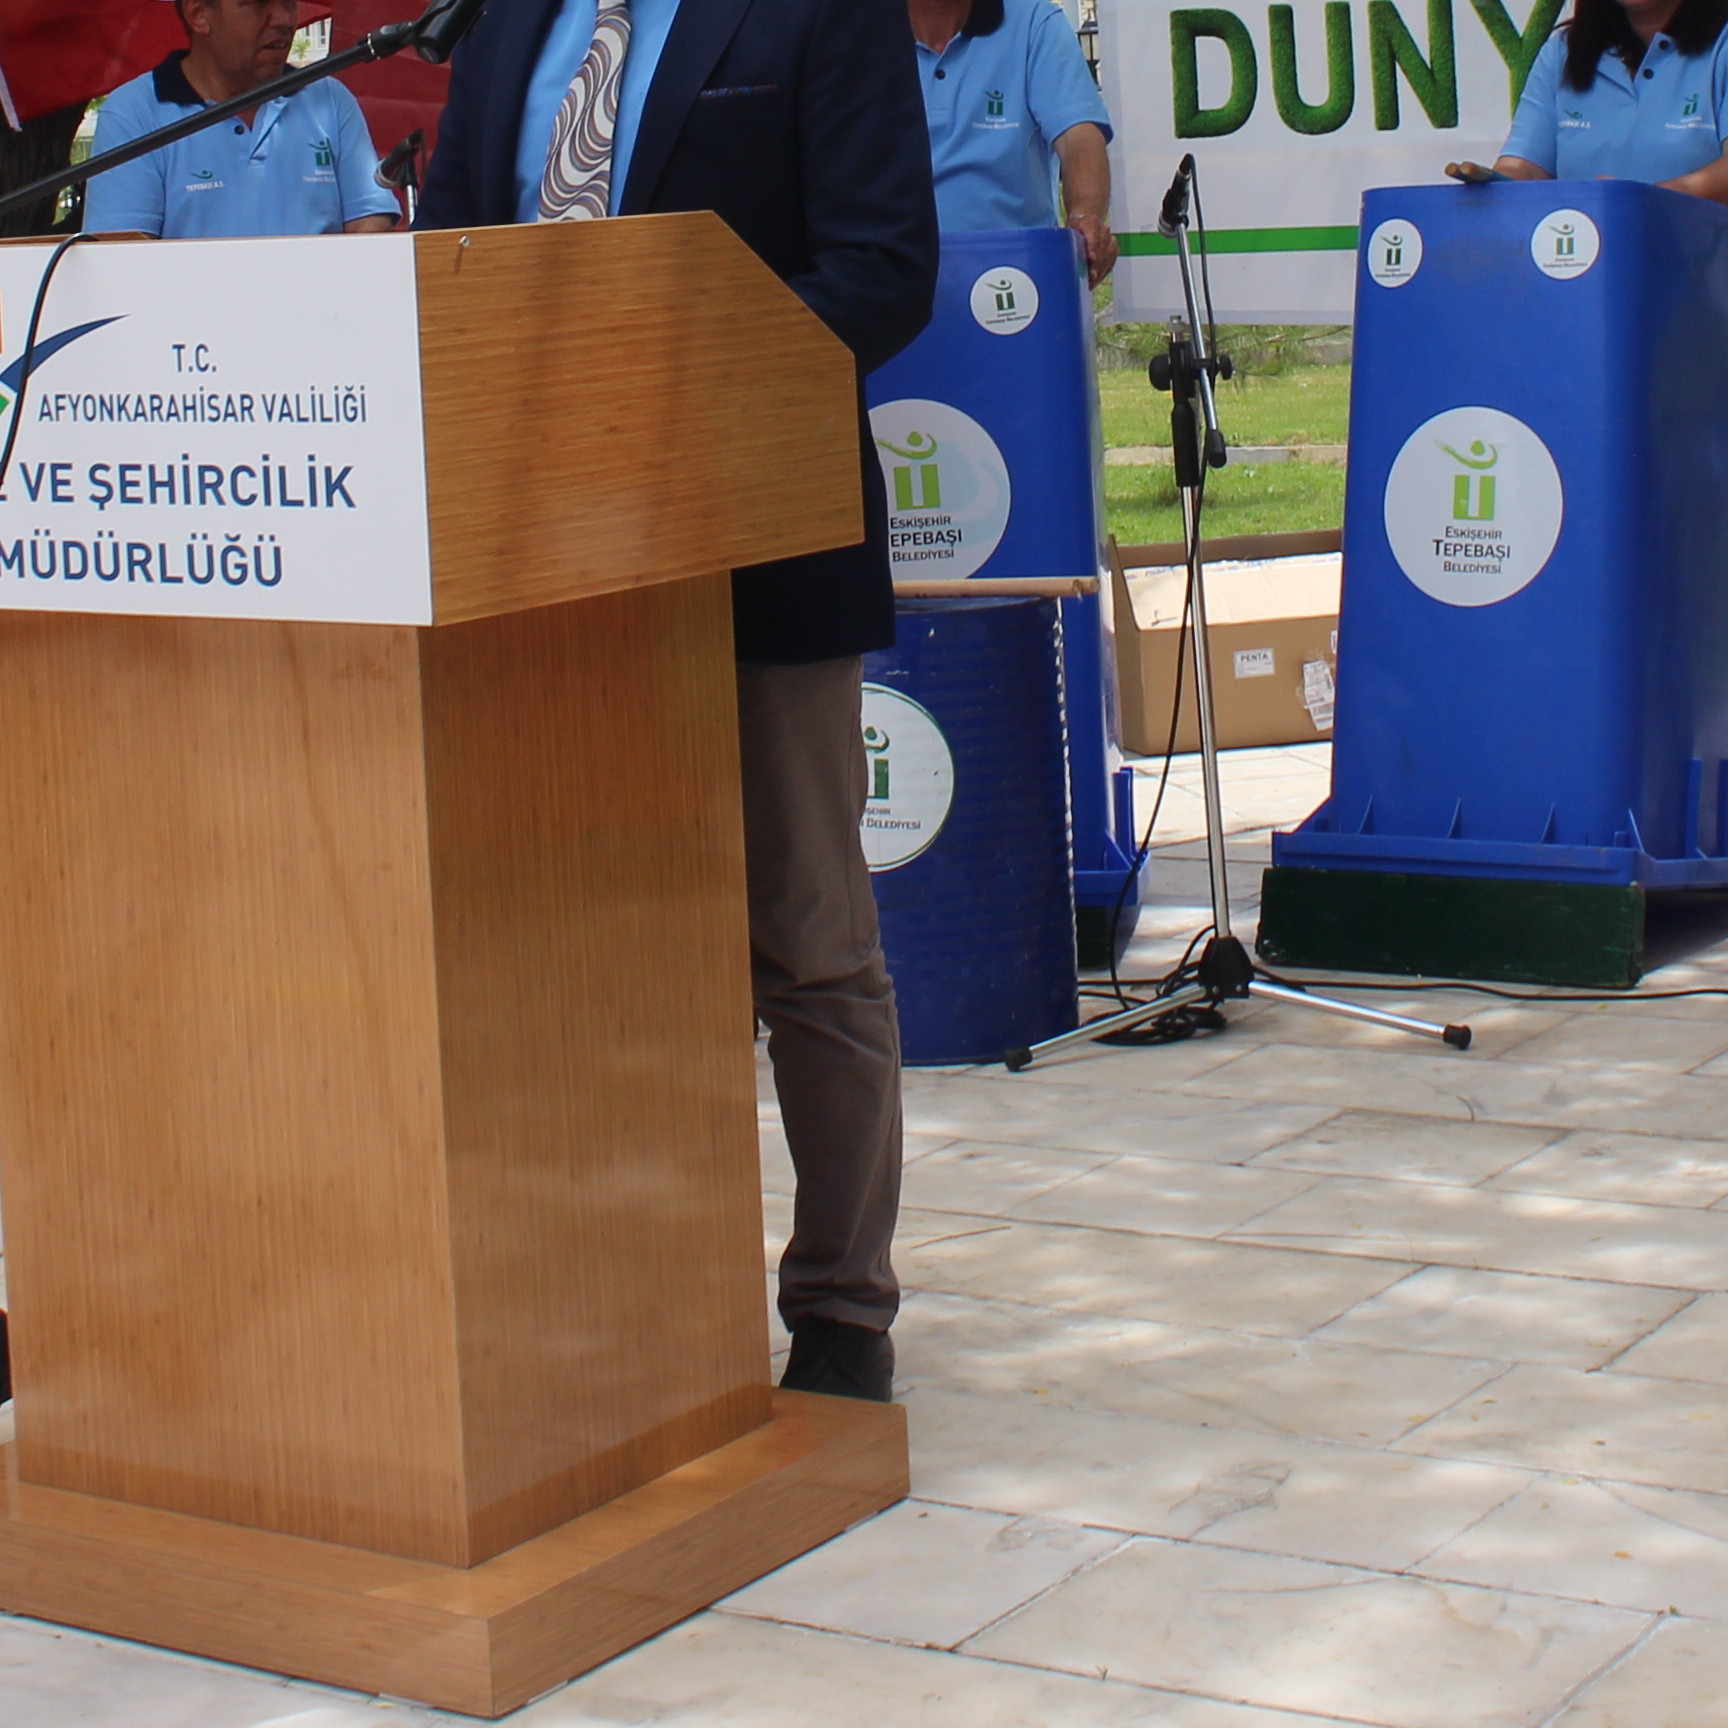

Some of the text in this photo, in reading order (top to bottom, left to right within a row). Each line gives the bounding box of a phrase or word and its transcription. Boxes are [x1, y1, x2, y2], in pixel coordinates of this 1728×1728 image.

[172, 344, 217, 374] T.C.
[38, 385, 369, 424] AFYONKARAHİSAR VALİLİĞİ
[19, 462, 75, 503] VE
[87, 452, 356, 511] ŞEHİRCİLİK
[890, 515, 951, 529] ESKİŞEHİR
[890, 529, 962, 547] EPEBAŞI
[1445, 526, 1502, 541] ESKİŞEHİR
[892, 548, 954, 563] BELEDİYESİ
[1432, 539, 1511, 560] TEPEBAŞI
[1443, 560, 1501, 574] BELEDİYESİ
[1240, 652, 1269, 663] PENTA
